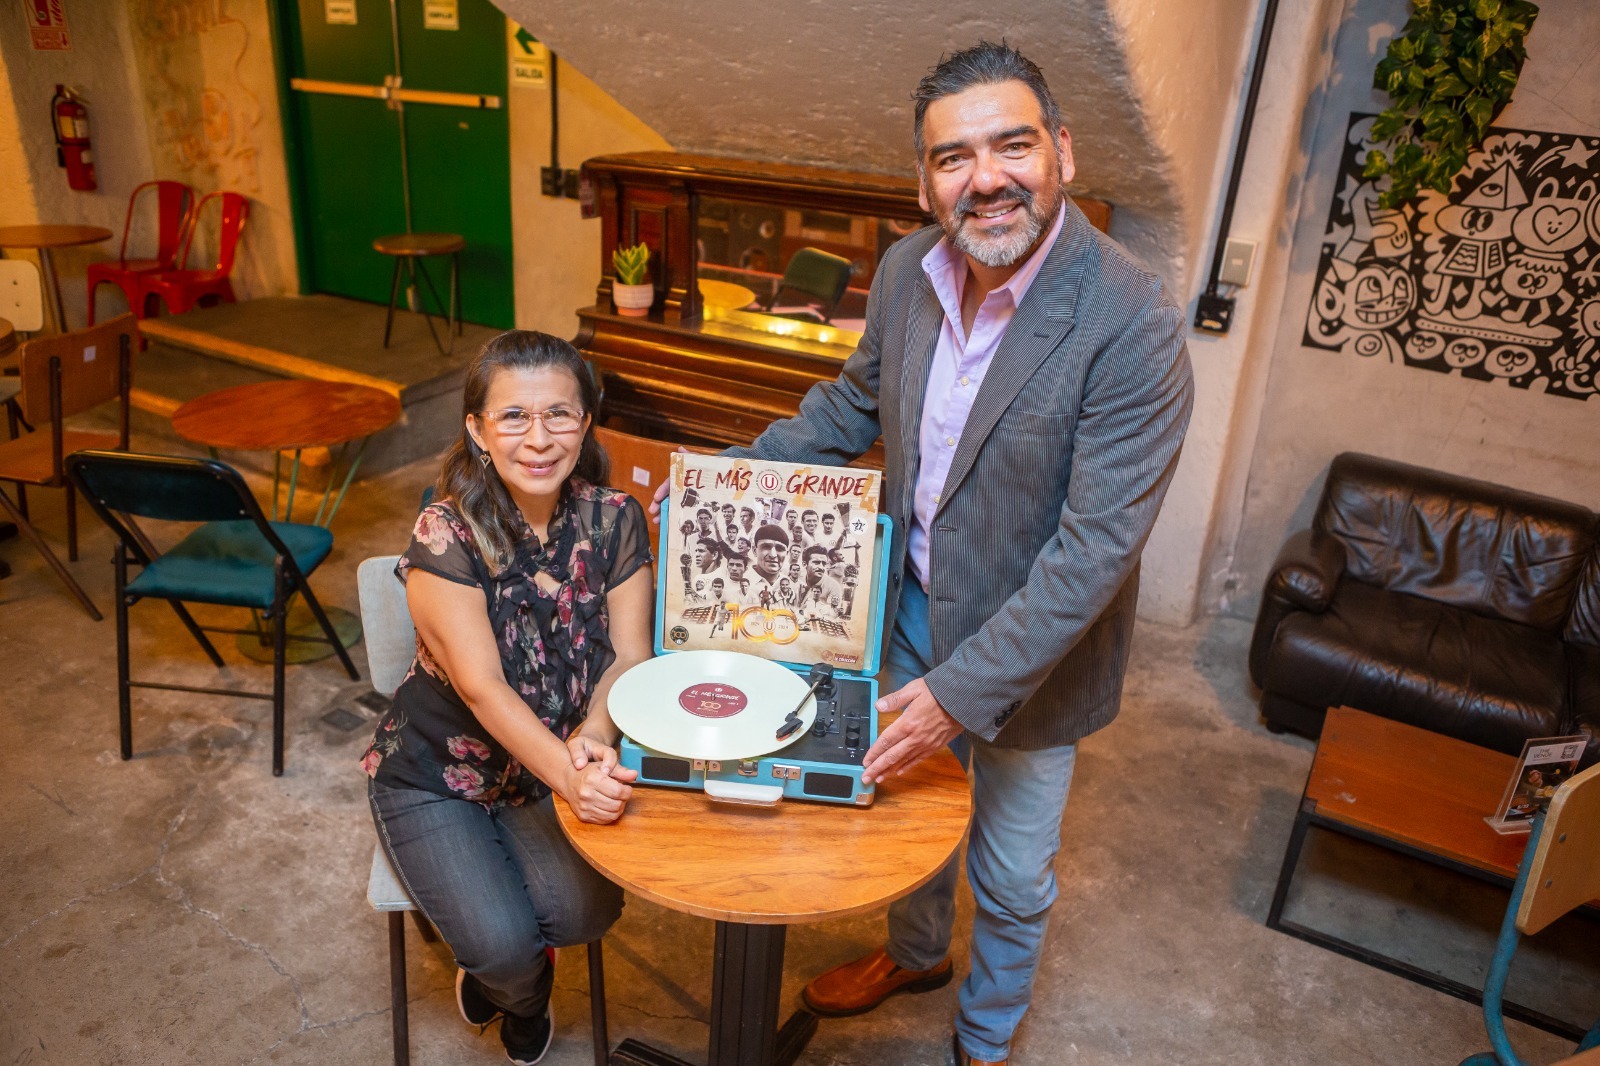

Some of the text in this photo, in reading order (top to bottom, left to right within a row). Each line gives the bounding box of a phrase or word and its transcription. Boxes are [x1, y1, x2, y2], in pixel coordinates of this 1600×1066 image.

[515, 67, 543, 79] SALIDA
[683, 469, 705, 489] EL
[715, 467, 753, 491] MÁS
[785, 473, 870, 499] GRANDE
[725, 602, 799, 645] 100
[700, 700, 721, 710] 100
